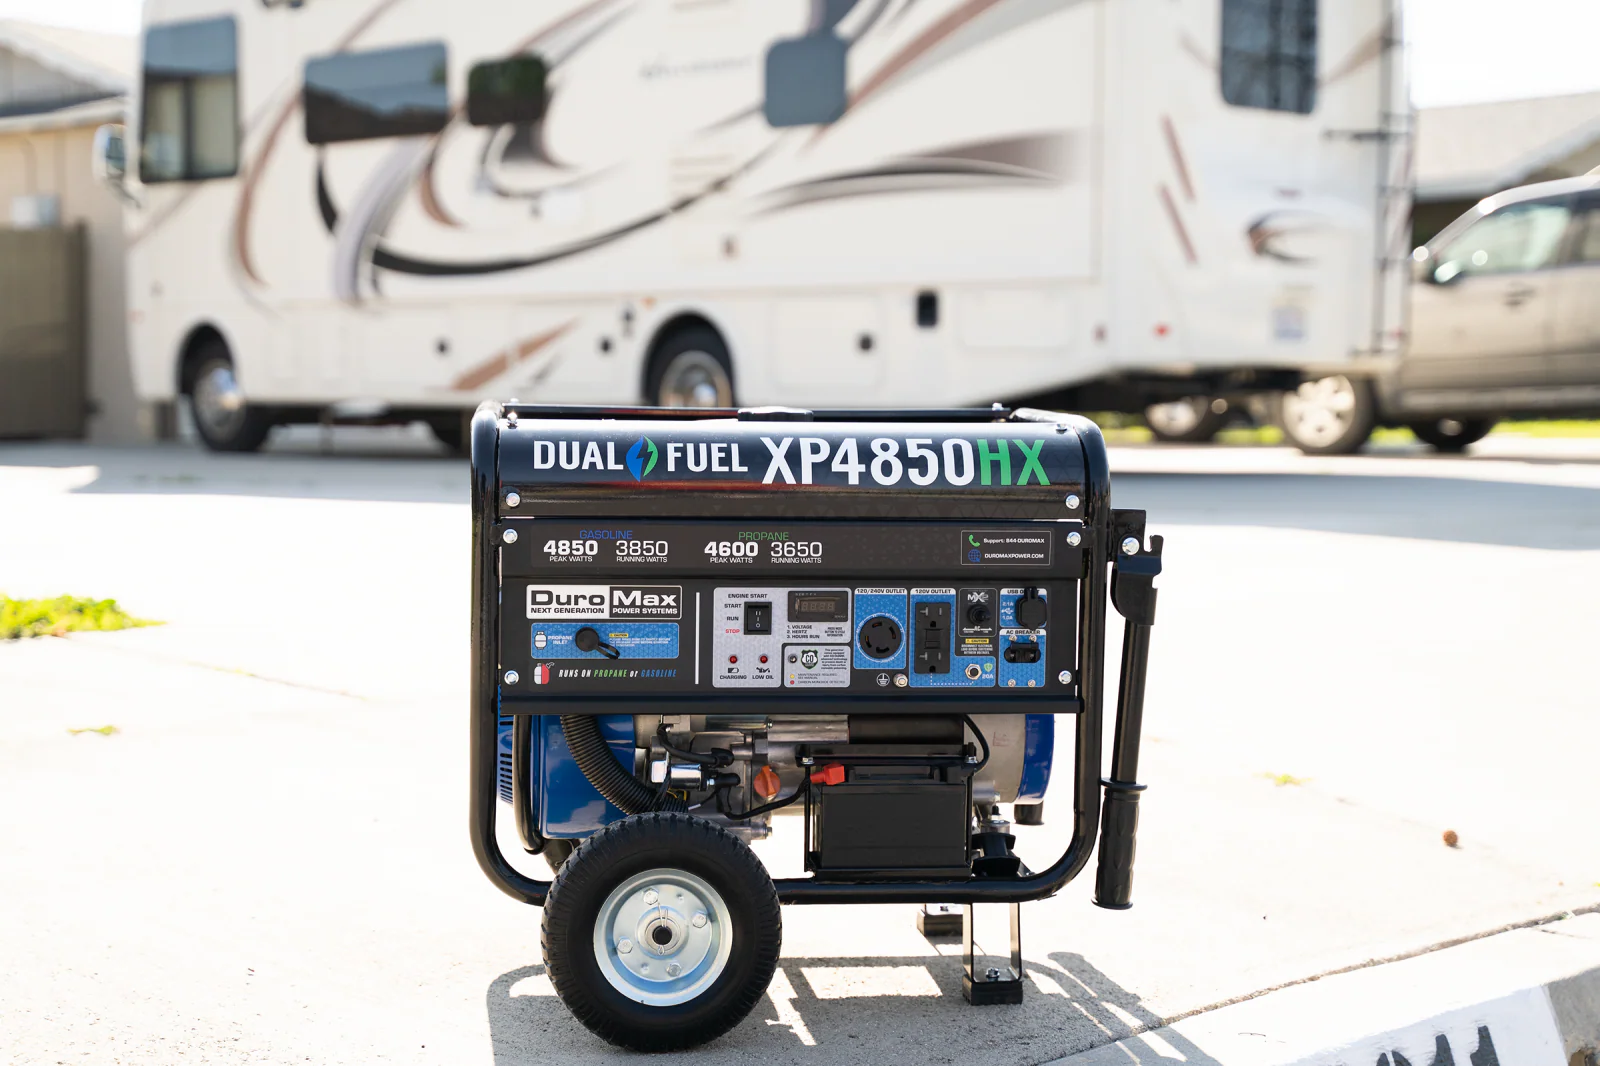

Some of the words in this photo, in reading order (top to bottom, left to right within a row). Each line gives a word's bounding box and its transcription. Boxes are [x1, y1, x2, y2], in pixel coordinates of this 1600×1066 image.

[533, 440, 624, 470] DUAL
[667, 442, 748, 472] FUEL
[760, 437, 1051, 486] XP4850HX
[579, 529, 633, 540] GASOLINE
[738, 531, 789, 541] PROPANE
[543, 540, 599, 556] 4850
[615, 540, 669, 556] 3850
[704, 541, 759, 557] 4600
[770, 541, 823, 557] 3650
[559, 669, 579, 678] RUNS
[581, 669, 591, 678] ON
[593, 669, 628, 678] PROPANE
[629, 670, 639, 678] or
[640, 669, 677, 678] GASOLINE
